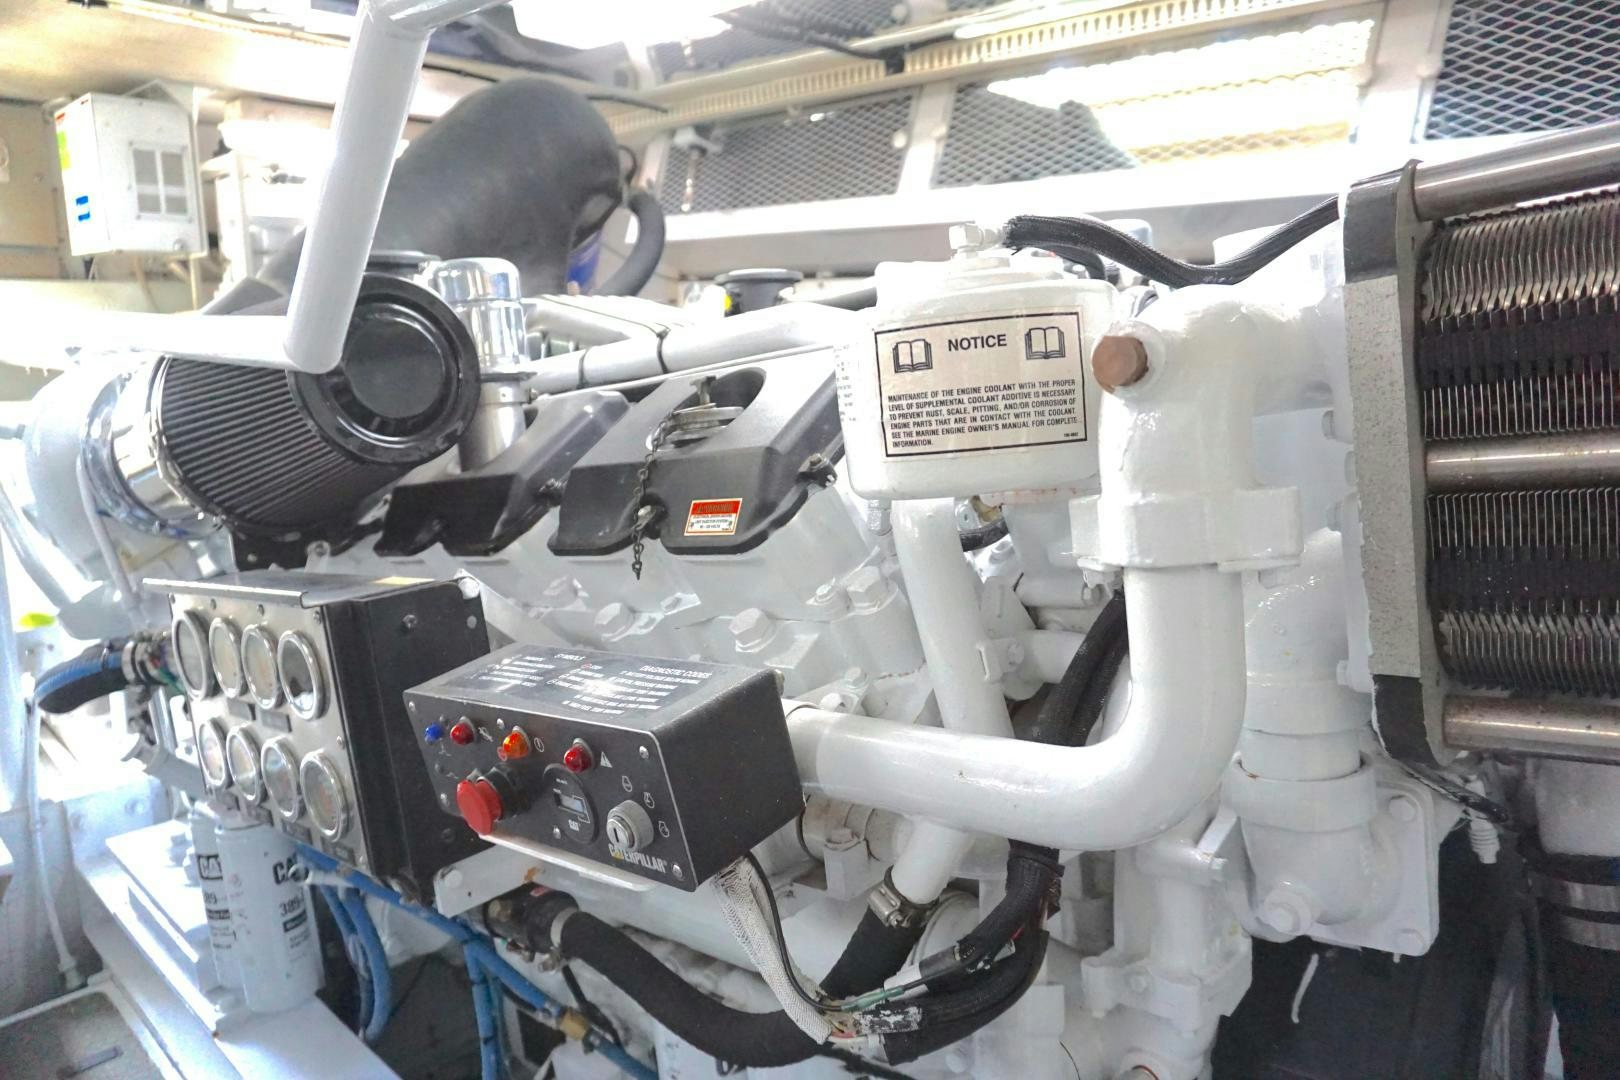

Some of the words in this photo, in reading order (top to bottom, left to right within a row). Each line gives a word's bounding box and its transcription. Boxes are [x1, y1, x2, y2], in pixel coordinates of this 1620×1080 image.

[948, 334, 1007, 352] NOTICE
[888, 393, 928, 402] MAINTENANCE
[957, 387, 981, 395] ENGINE
[984, 384, 1015, 393] COOLANT
[916, 398, 965, 409] SUPPLEMENTAL
[968, 395, 999, 404] COOLANT
[1002, 392, 1032, 401] ADDITIVE
[1042, 388, 1075, 397] NECESSARY
[898, 411, 923, 419] PREVENT
[1032, 399, 1067, 407] CORROSION
[980, 413, 1010, 422] CONTACT
[1014, 411, 1031, 419] WITH
[942, 427, 965, 435] ENGINE
[968, 423, 999, 432] OWNER'S
[1047, 417, 1077, 425] COMPLETE
[893, 440, 933, 448] INFORMATION.
